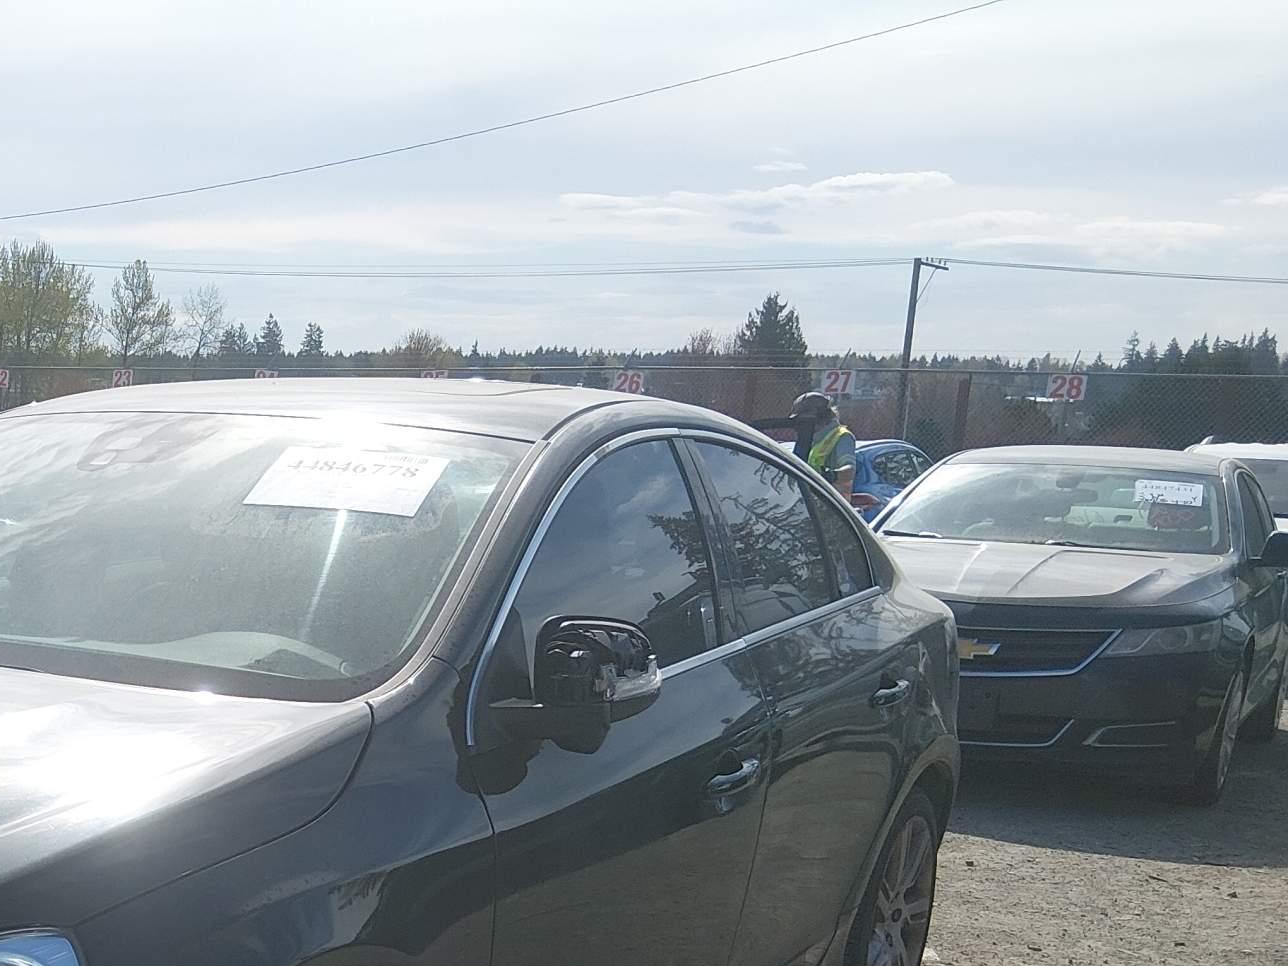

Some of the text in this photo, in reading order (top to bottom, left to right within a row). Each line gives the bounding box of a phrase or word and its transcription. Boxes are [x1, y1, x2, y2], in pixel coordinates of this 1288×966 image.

[114, 371, 132, 387] 23
[614, 372, 642, 393] 26
[825, 371, 852, 393] 27
[1049, 375, 1084, 400] 28
[287, 459, 420, 478] 44846778
